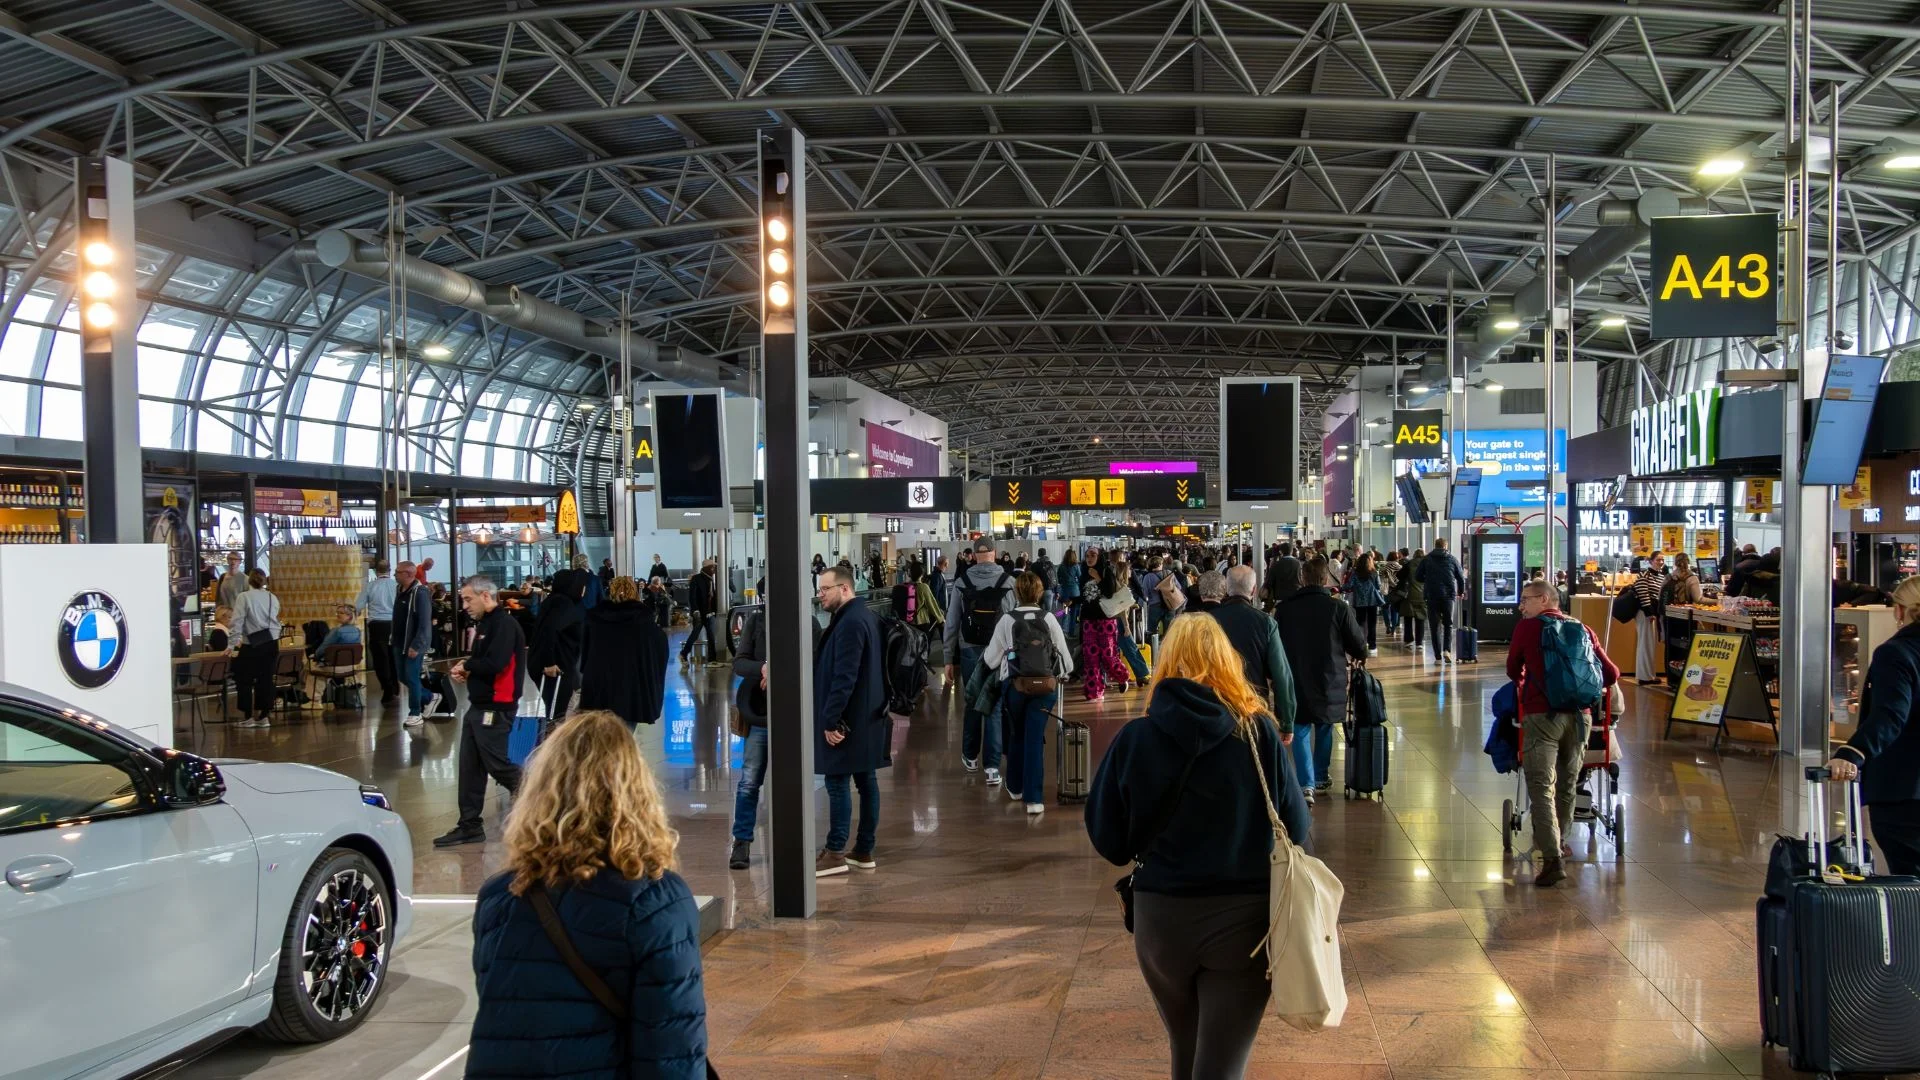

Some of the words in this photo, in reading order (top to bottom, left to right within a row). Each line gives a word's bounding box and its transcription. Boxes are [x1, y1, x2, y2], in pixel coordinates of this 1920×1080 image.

[1660, 253, 1770, 300] A43
[1395, 424, 1441, 445] A45
[636, 439, 654, 459] A
[1465, 440, 1487, 449] Your
[1490, 440, 1511, 450] gate
[1514, 440, 1524, 448] to
[871, 443, 888, 460] Welcome
[893, 450, 914, 469] Copenhagen
[1483, 451, 1517, 460] largest
[1502, 463, 1512, 472] in
[1514, 463, 1530, 472] the
[1080, 487, 1087, 496] A
[1106, 487, 1118, 502] T
[1685, 509, 1725, 529] SELF
[1579, 535, 1633, 556] REFILL
[64, 593, 122, 627] BMW
[1486, 607, 1513, 615] Revolut
[1698, 638, 1735, 652] breakfast
[1699, 649, 1730, 660] express
